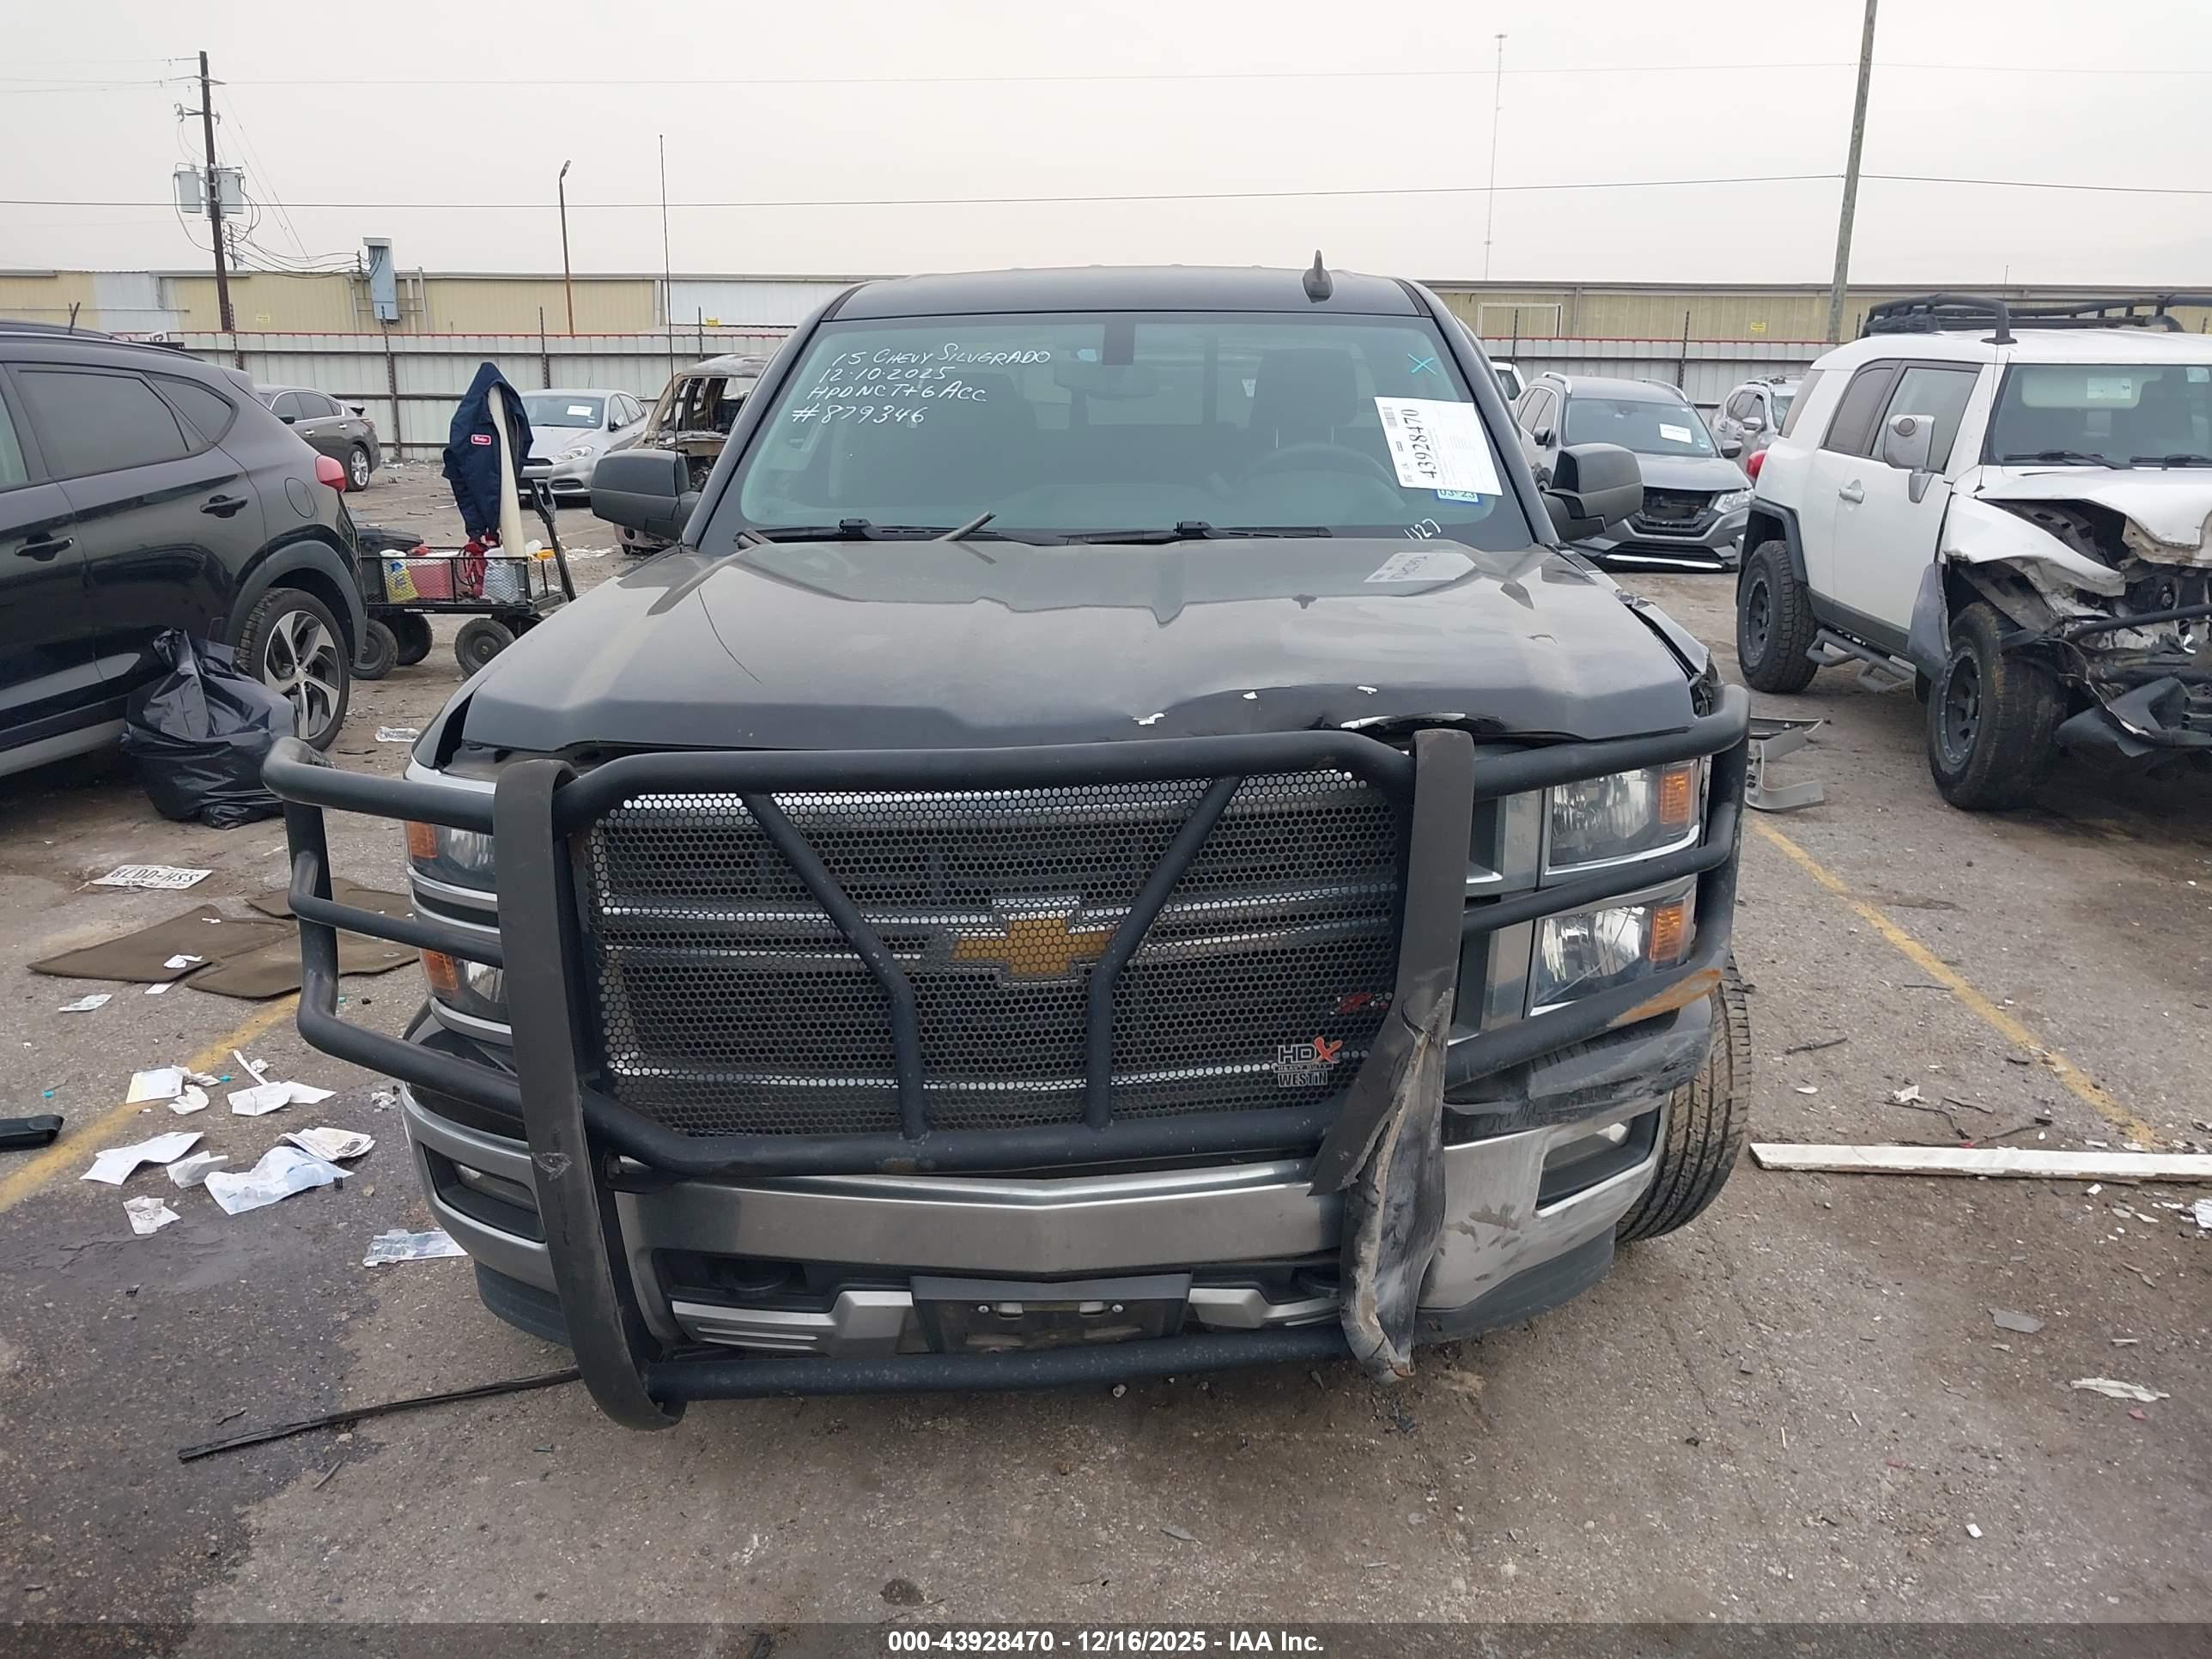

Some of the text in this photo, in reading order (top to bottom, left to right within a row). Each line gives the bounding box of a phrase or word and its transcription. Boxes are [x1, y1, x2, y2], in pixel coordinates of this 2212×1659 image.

[831, 351, 867, 368] 15
[1401, 409, 1437, 479] 43928470
[1277, 1036, 1343, 1064] HDX
